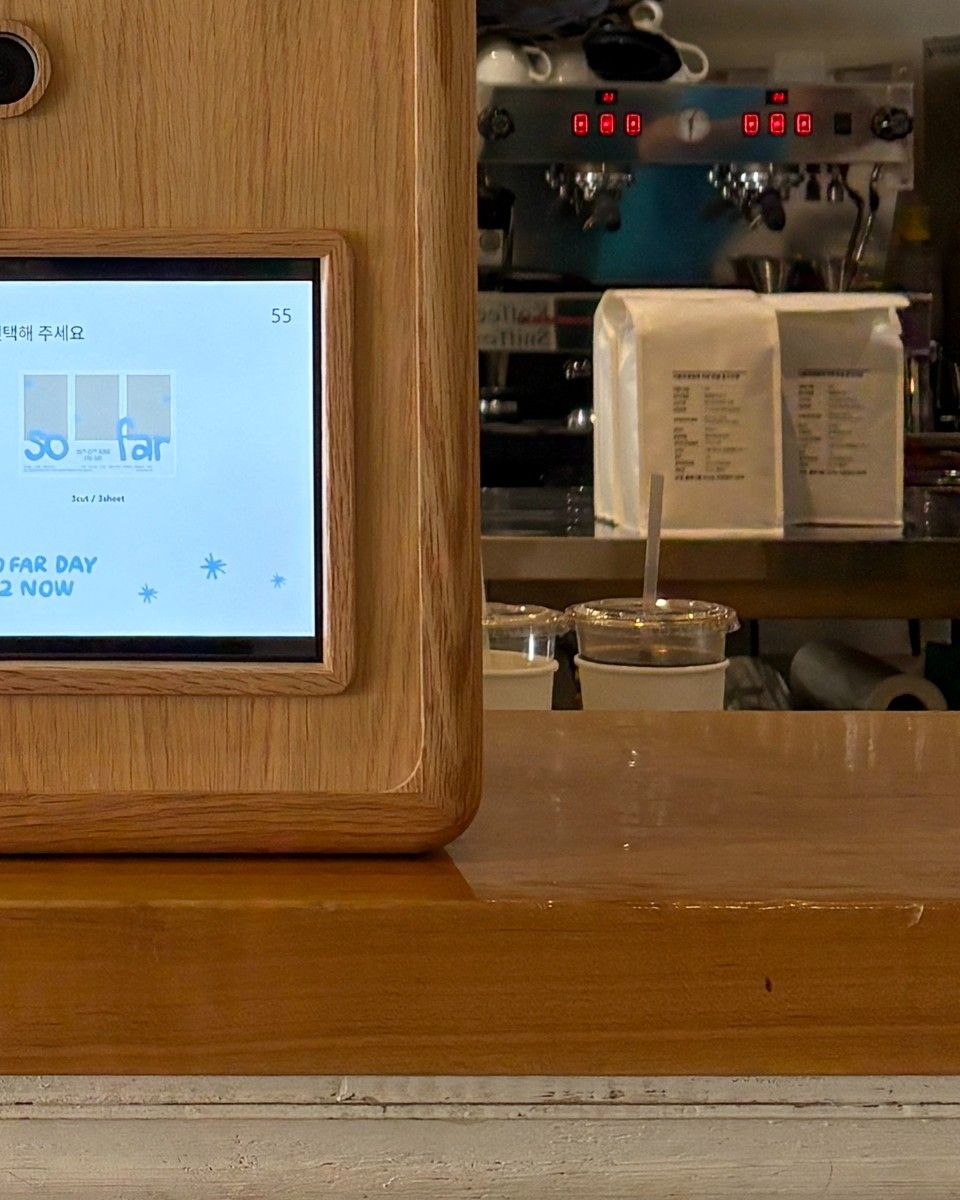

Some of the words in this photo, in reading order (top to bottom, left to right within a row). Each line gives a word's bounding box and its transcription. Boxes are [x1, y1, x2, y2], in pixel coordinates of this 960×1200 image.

[271, 307, 292, 324] 55
[37, 324, 85, 342] 주세요
[9, 555, 47, 574] FAR
[55, 555, 98, 574] DAY
[20, 580, 74, 598] NOW
